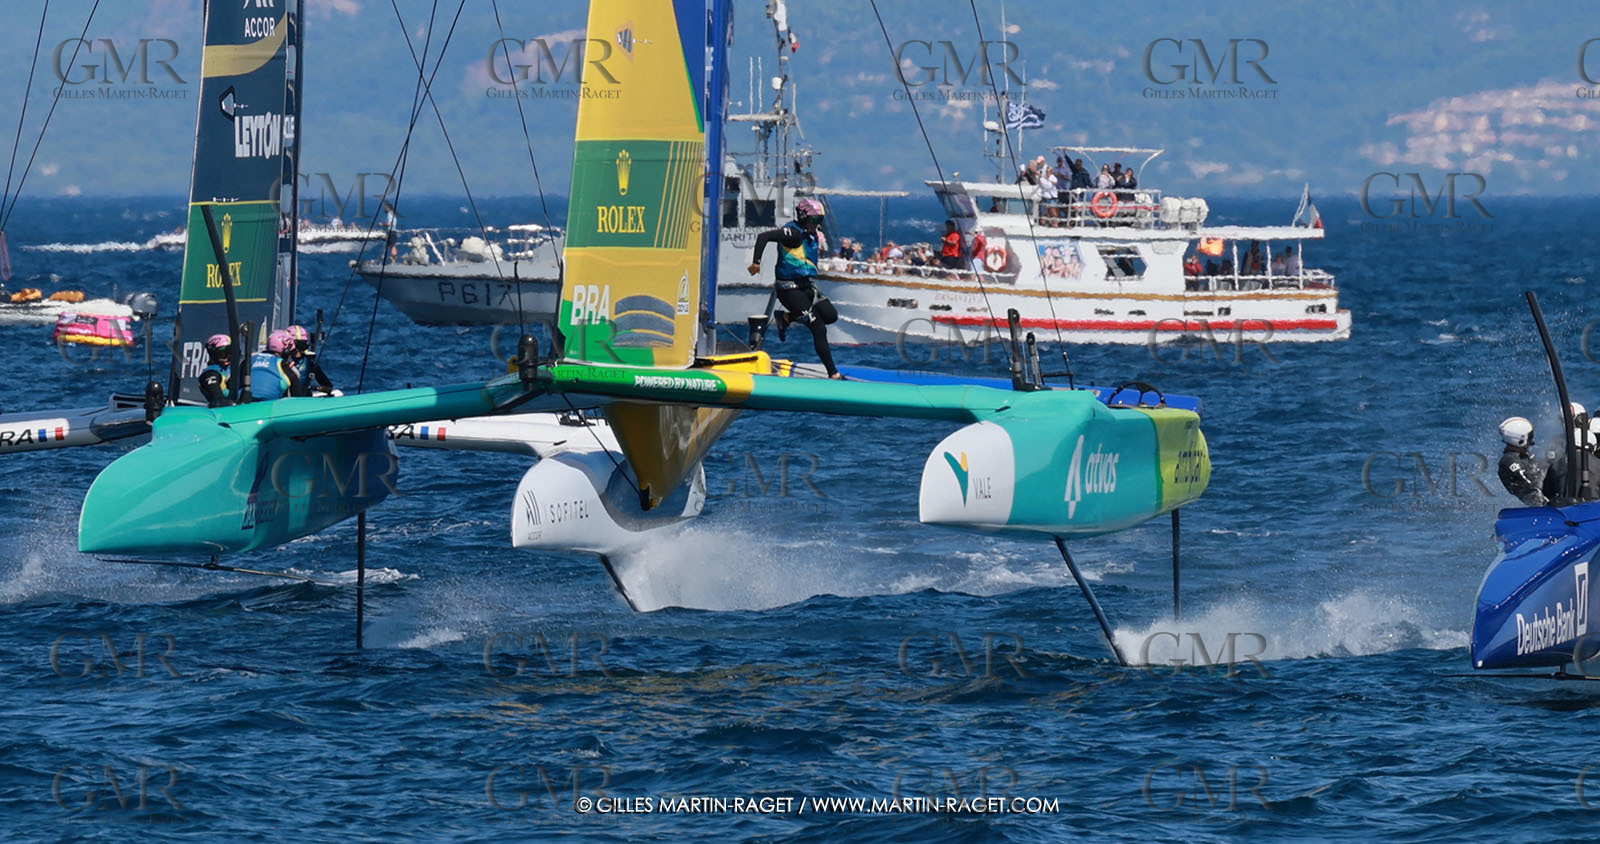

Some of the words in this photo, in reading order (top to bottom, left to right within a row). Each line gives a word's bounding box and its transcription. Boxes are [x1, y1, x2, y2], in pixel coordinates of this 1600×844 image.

[244, 17, 275, 38] ACCOR
[234, 112, 281, 159] LEYTON
[597, 206, 646, 233] ROLEX
[205, 261, 242, 288] ROEX
[438, 281, 512, 306] P617
[571, 284, 610, 325] BRA
[634, 375, 673, 388] POWERED
[674, 377, 684, 389] BY
[1085, 443, 1120, 494] atvos
[973, 476, 992, 500] VALE
[550, 500, 589, 524] SOFITEL
[1516, 606, 1556, 656] Deutsche
[1556, 597, 1575, 645] Bank
